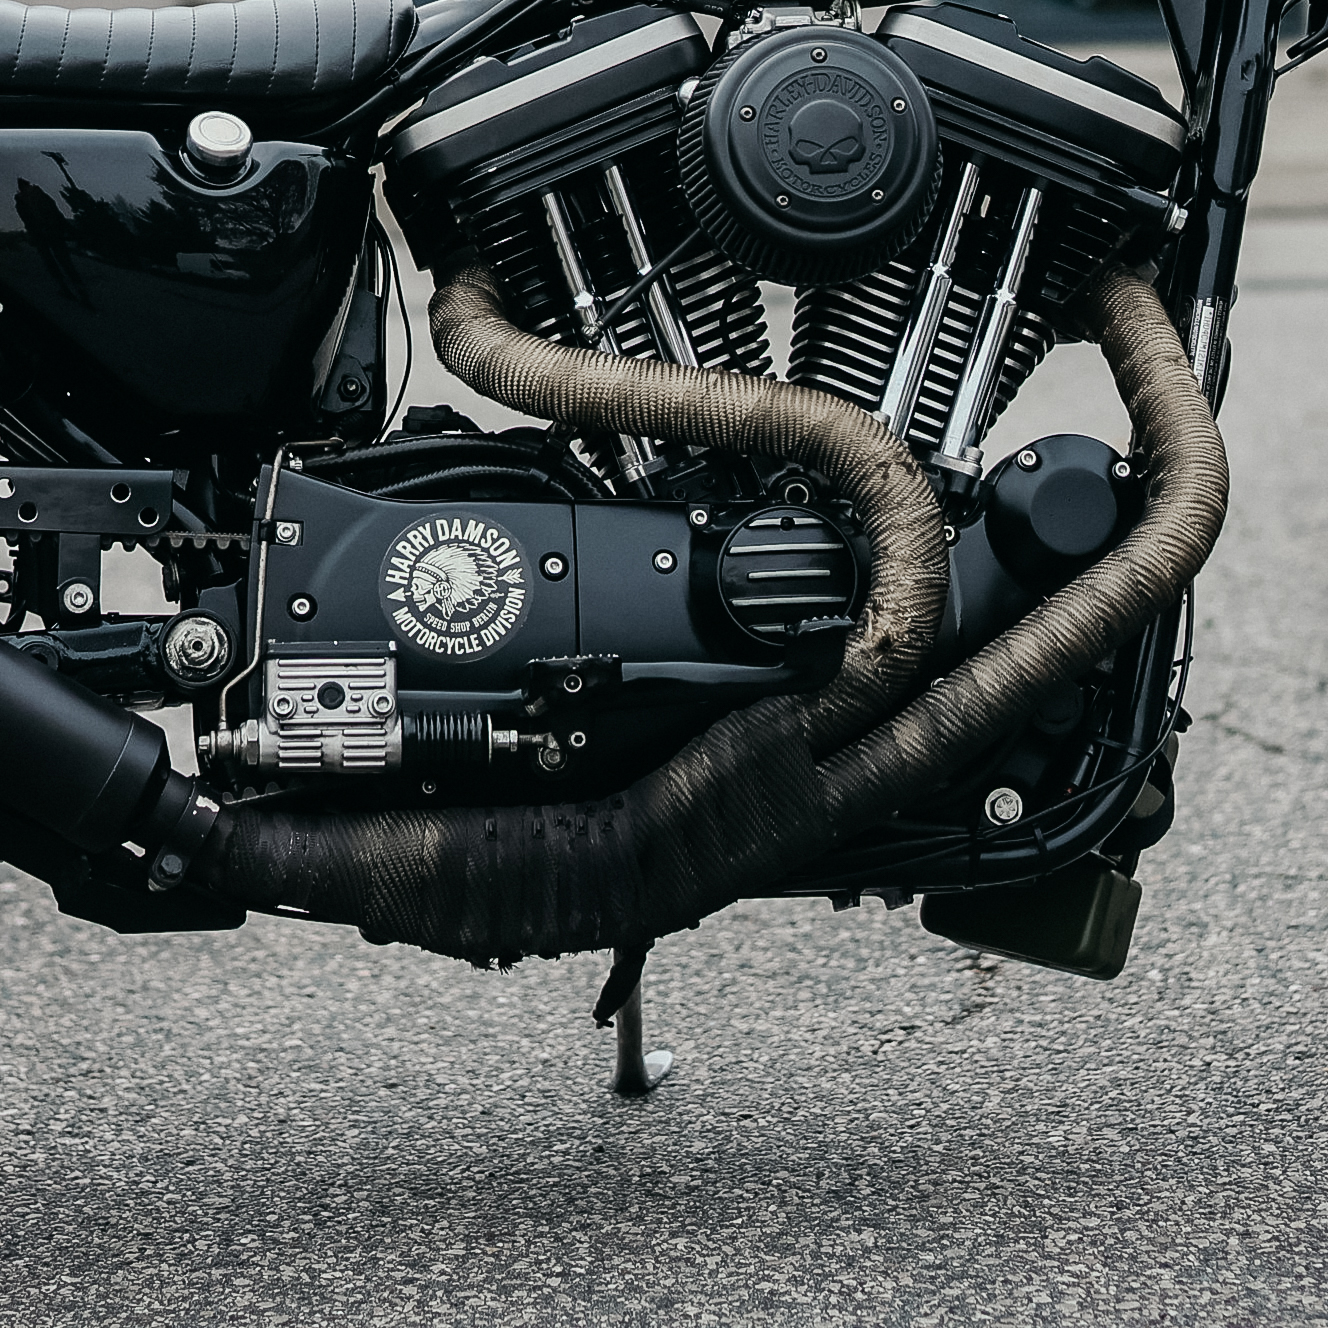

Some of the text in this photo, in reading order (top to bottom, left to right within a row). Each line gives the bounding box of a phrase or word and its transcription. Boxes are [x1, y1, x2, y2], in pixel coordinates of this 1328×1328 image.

[773, 151, 884, 196] MOTORCYCLES
[385, 518, 521, 585] HARRY DAMSON
[392, 586, 526, 655] MOTORCYCLE DIVISION
[423, 601, 498, 633] SPEED SHOP BERLIN
